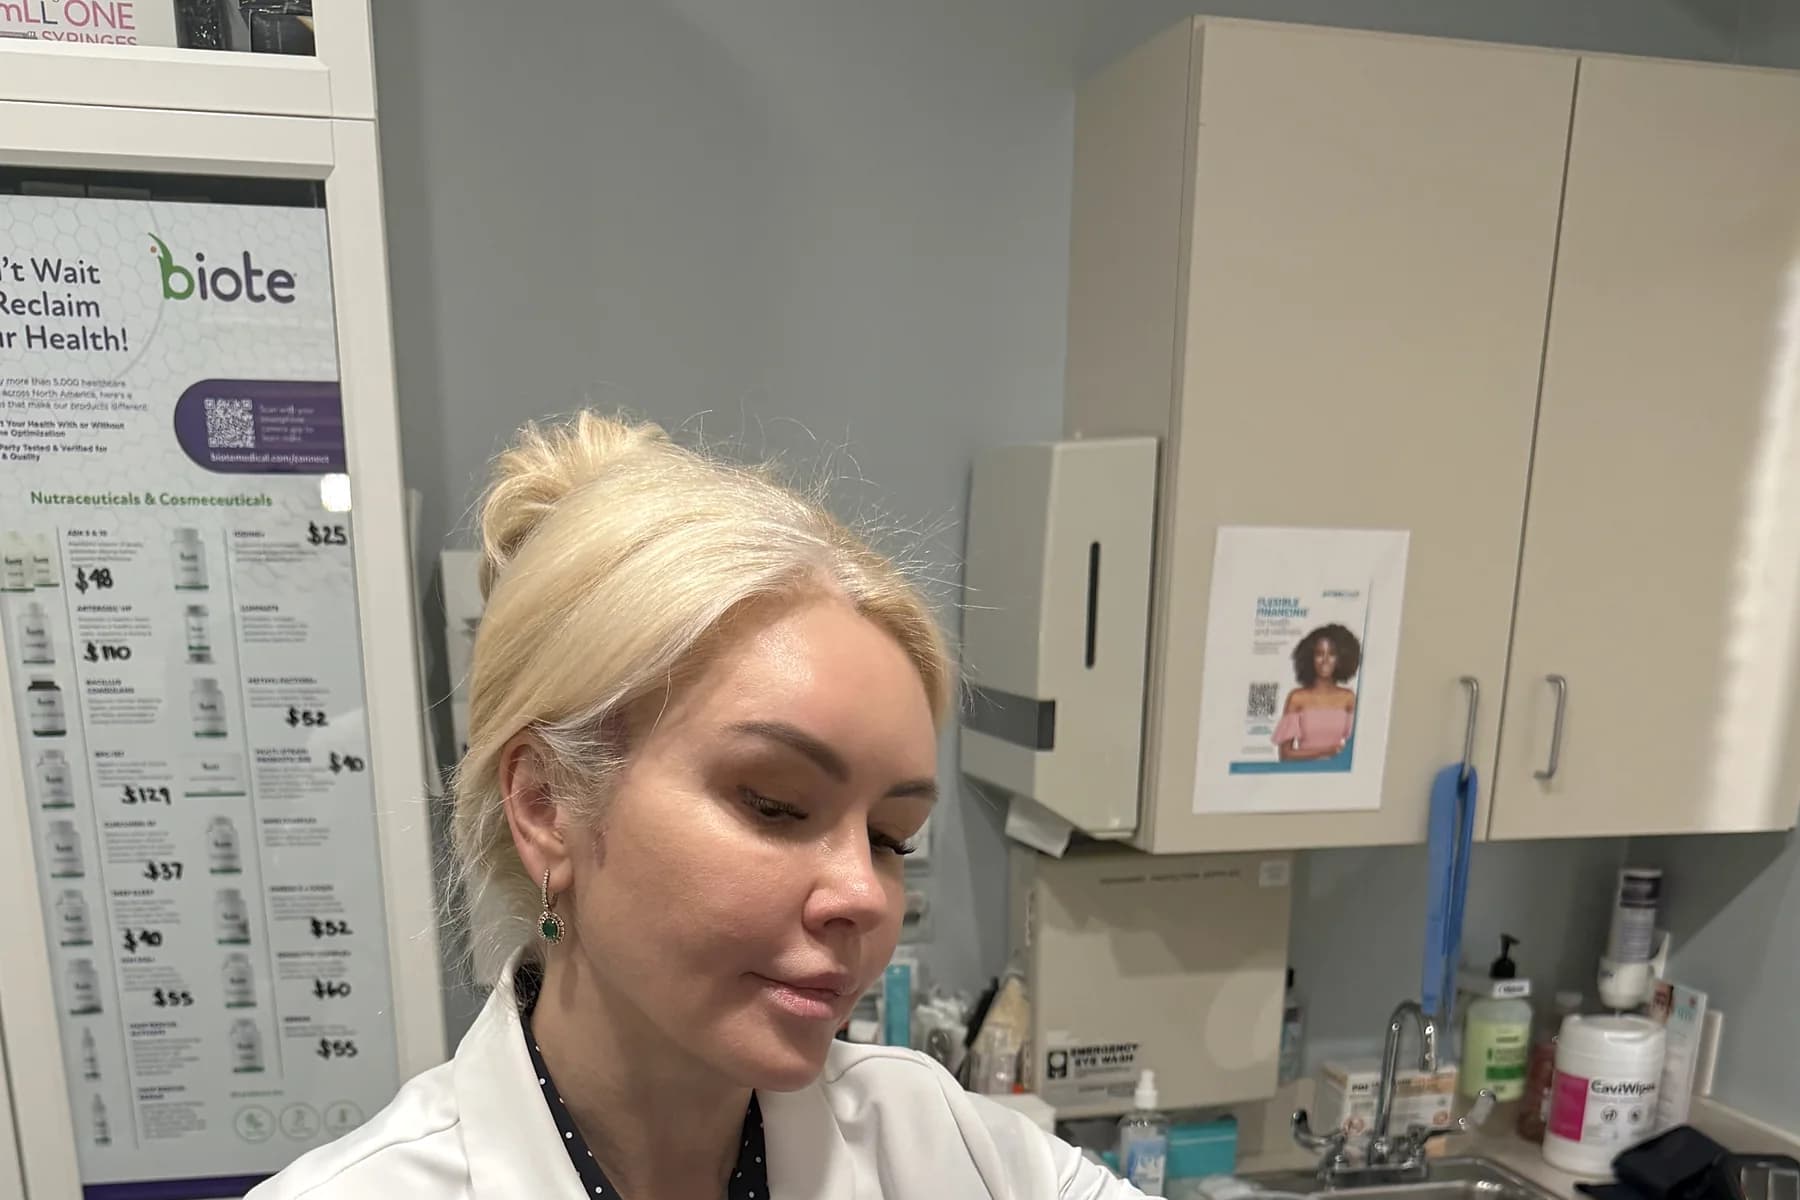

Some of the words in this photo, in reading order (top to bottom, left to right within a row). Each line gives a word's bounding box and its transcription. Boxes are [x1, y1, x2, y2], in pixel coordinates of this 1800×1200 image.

[31, 257, 101, 284] Wait
[148, 232, 297, 304] biote
[25, 325, 129, 352] Health!
[30, 491, 142, 506] Nutraceuticals
[145, 493, 156, 506] &
[159, 493, 274, 508] Cosmeceuticals
[307, 520, 348, 547] $25
[285, 705, 330, 728] $52
[121, 784, 172, 806] $129
[143, 860, 184, 882] $37
[311, 917, 354, 938] $52
[153, 986, 194, 1008] $55
[312, 978, 352, 1000] $60
[316, 1037, 358, 1060] $55
